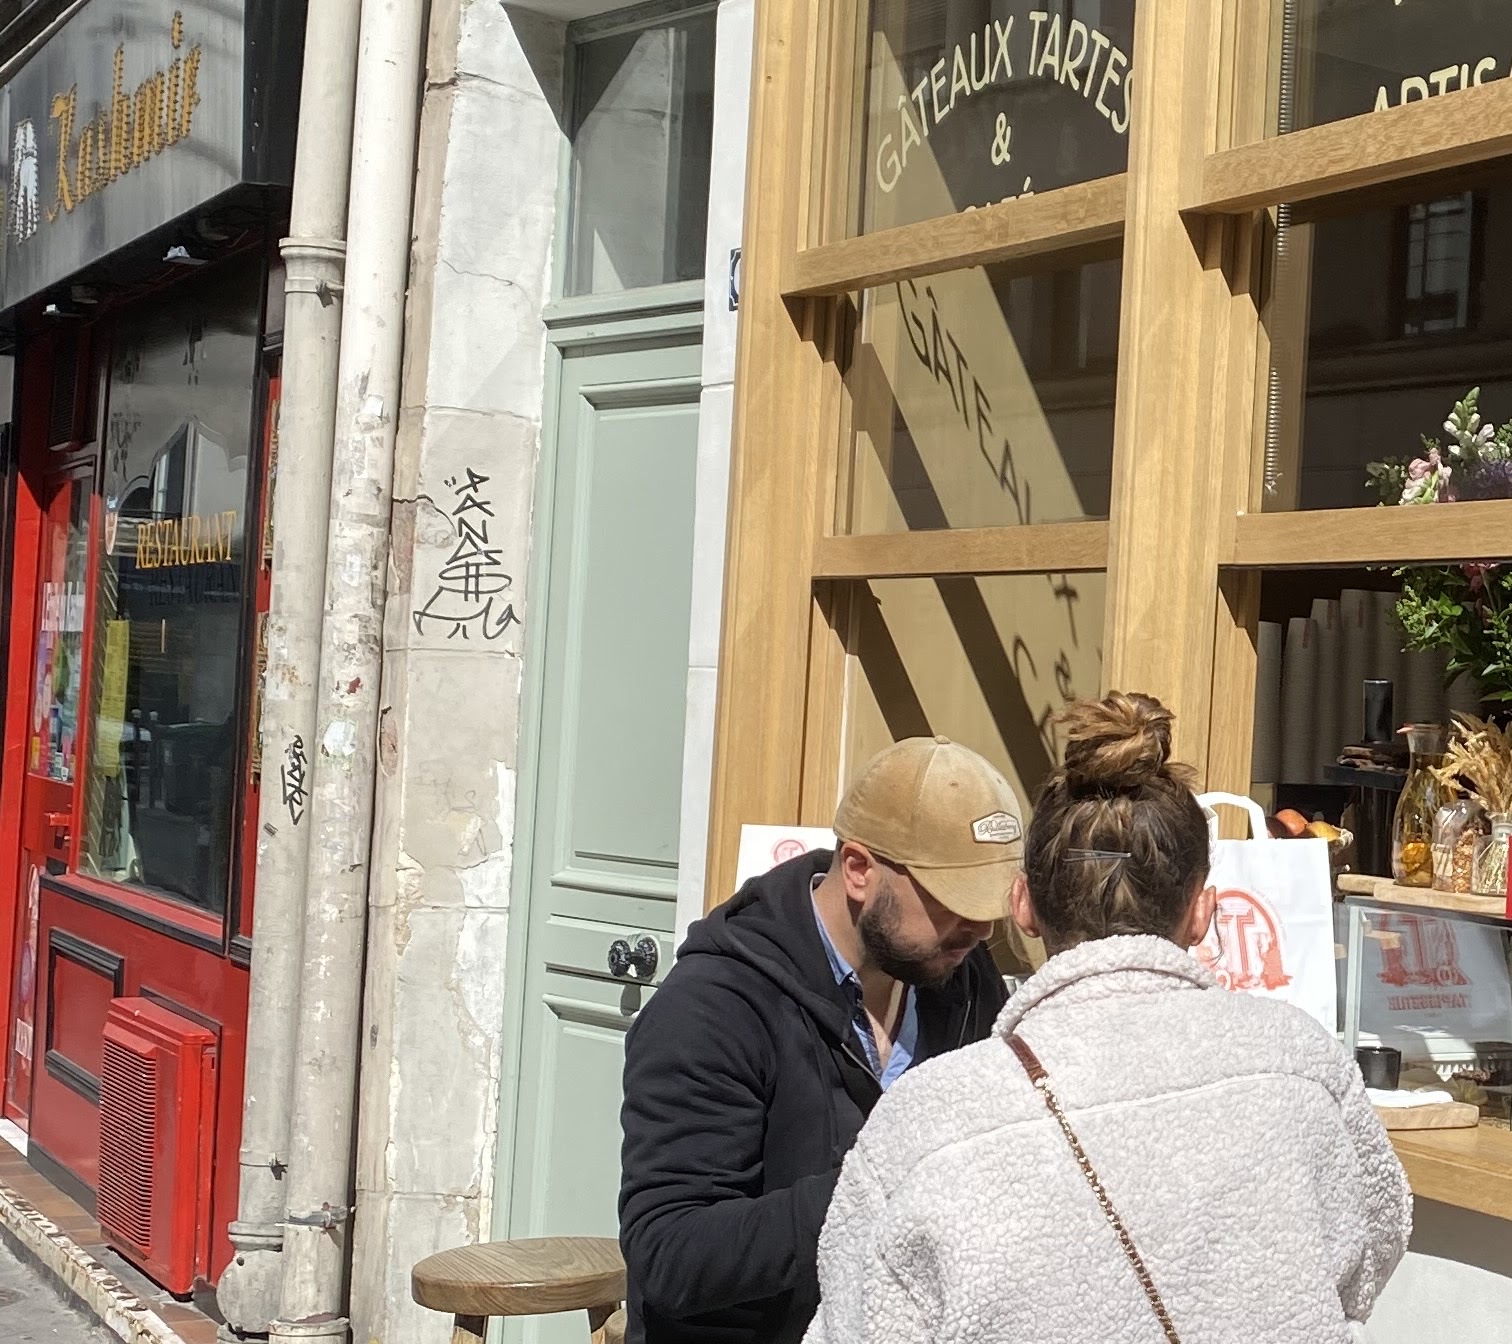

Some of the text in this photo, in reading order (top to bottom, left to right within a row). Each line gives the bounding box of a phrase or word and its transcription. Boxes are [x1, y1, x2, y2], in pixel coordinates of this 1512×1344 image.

[876, 10, 1135, 192] GÂTEAUX TARTES
[991, 112, 1012, 166] &
[135, 510, 237, 569] RESTAURANT
